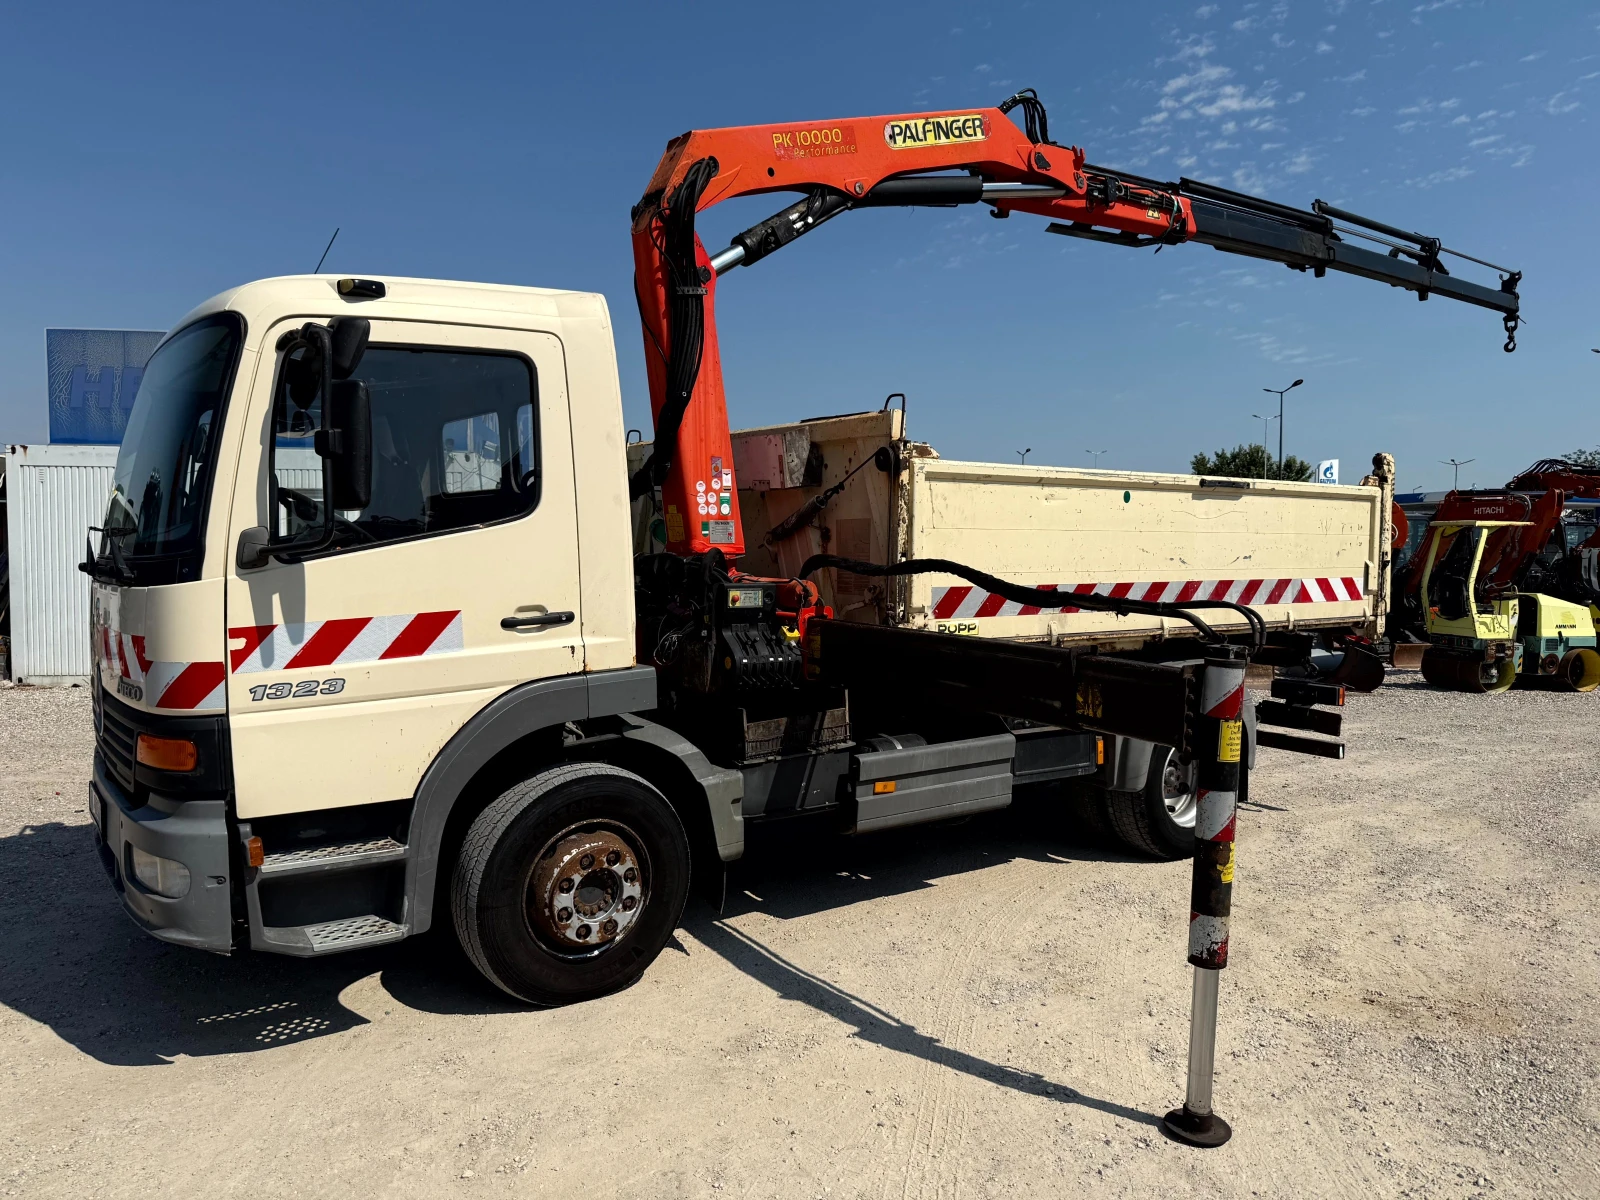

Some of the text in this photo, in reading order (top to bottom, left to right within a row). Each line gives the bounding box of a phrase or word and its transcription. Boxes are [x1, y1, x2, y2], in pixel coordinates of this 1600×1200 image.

[772, 128, 842, 149] PK 10000
[890, 117, 984, 146] PALFINGER
[1473, 506, 1505, 515] HITACHI
[249, 677, 345, 701] 1323
